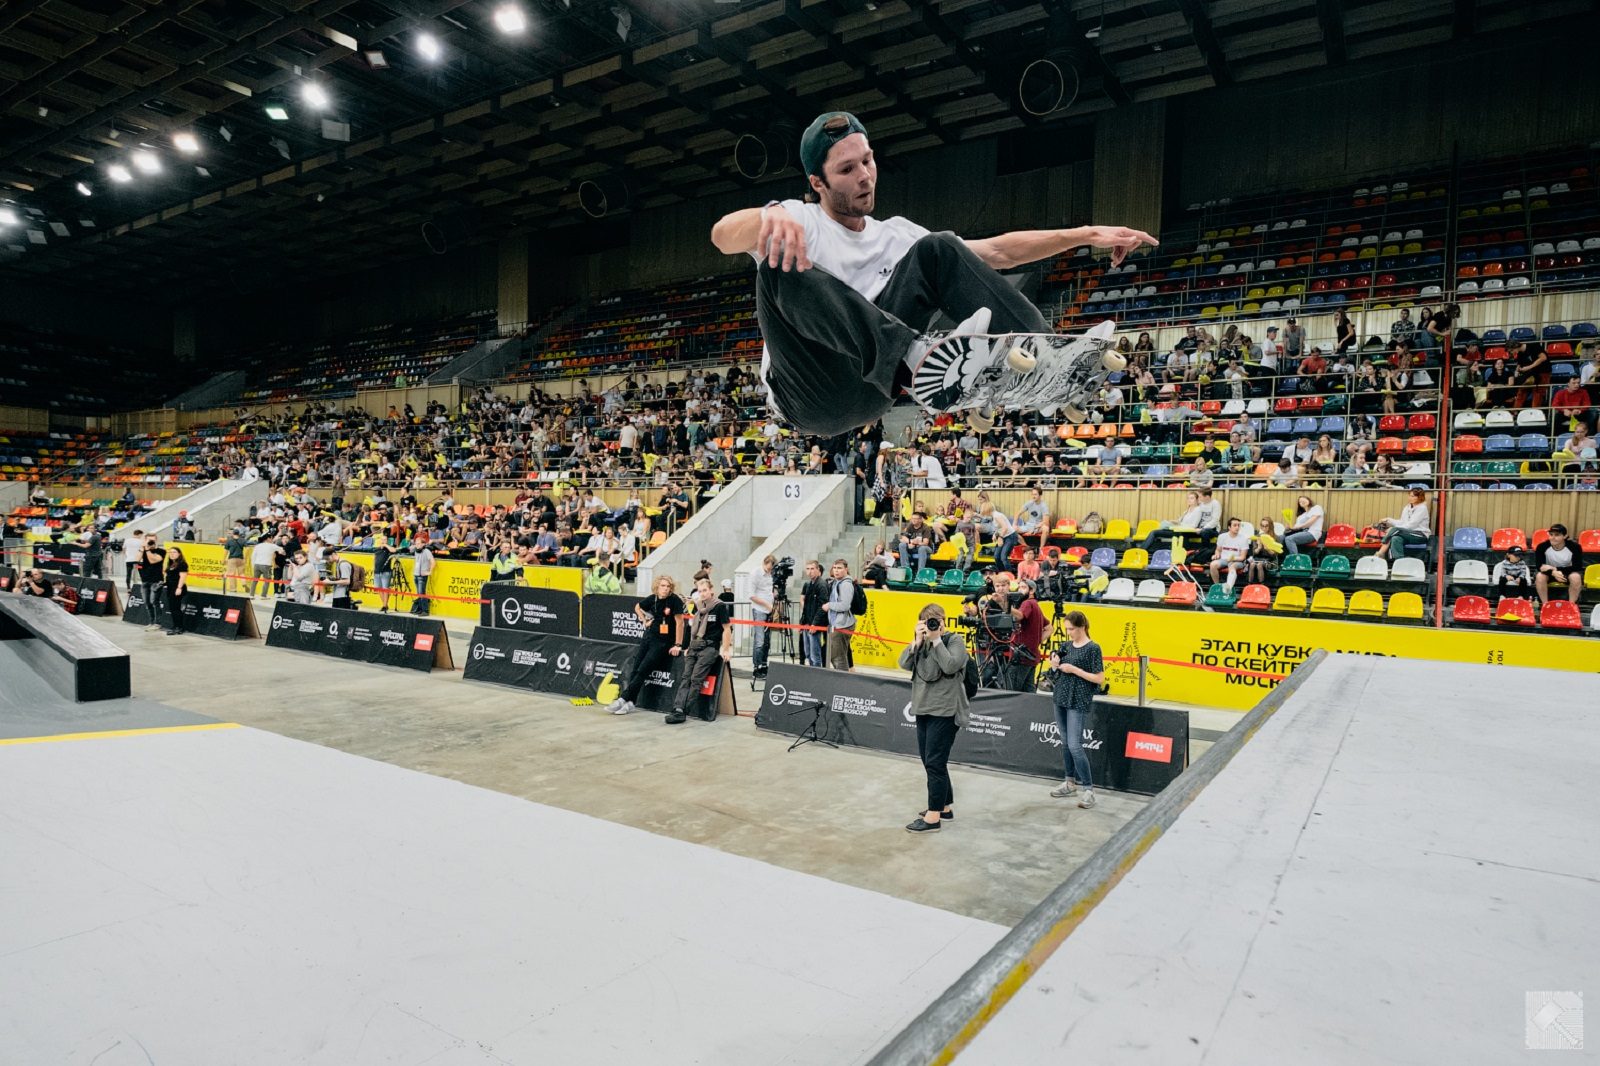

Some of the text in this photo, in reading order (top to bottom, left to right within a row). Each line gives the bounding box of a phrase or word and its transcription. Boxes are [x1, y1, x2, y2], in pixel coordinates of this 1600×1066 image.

[448, 585, 459, 595] ПО
[612, 611, 637, 620] WORLD
[612, 619, 646, 630] SKATEBOA
[612, 627, 645, 638] MOSCOW
[1200, 638, 1313, 659] ЭТАП КУБК
[1192, 652, 1218, 667] ПО
[1225, 673, 1281, 689] МОСК
[844, 696, 864, 705] WORLD
[864, 698, 877, 706] CUP
